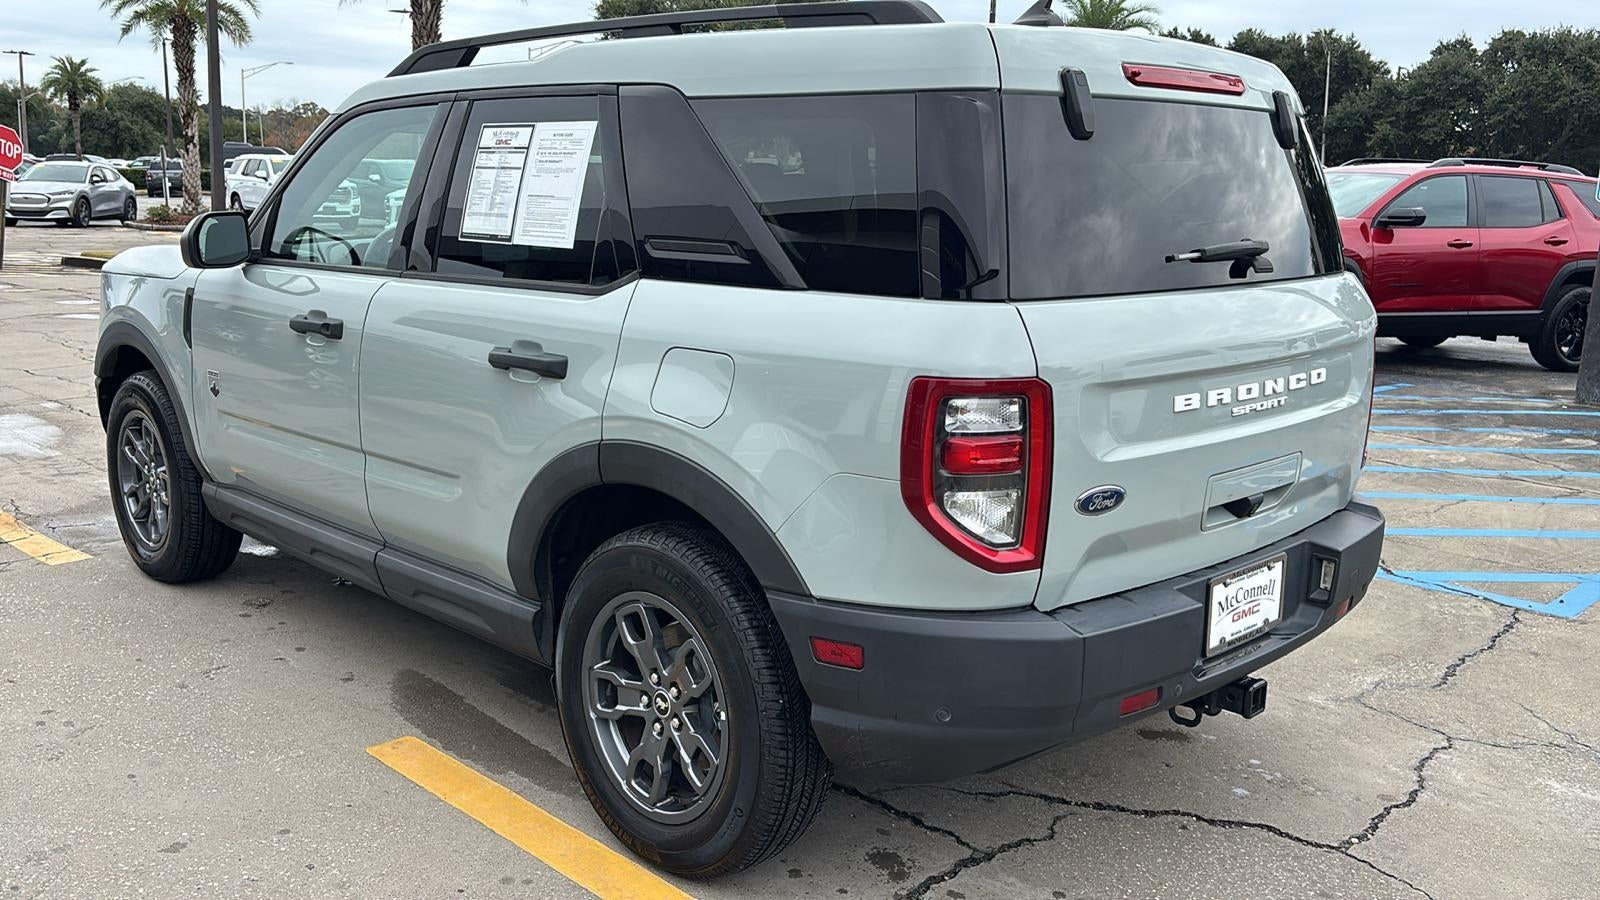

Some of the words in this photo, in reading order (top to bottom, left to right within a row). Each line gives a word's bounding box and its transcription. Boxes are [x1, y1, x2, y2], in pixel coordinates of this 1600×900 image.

[0, 138, 21, 158] TOP
[1173, 367, 1327, 412] BRONCO
[1231, 396, 1288, 417] SPORT
[1089, 492, 1117, 510] Ford
[1217, 578, 1276, 617] McConnell
[1232, 603, 1260, 622] GMC
